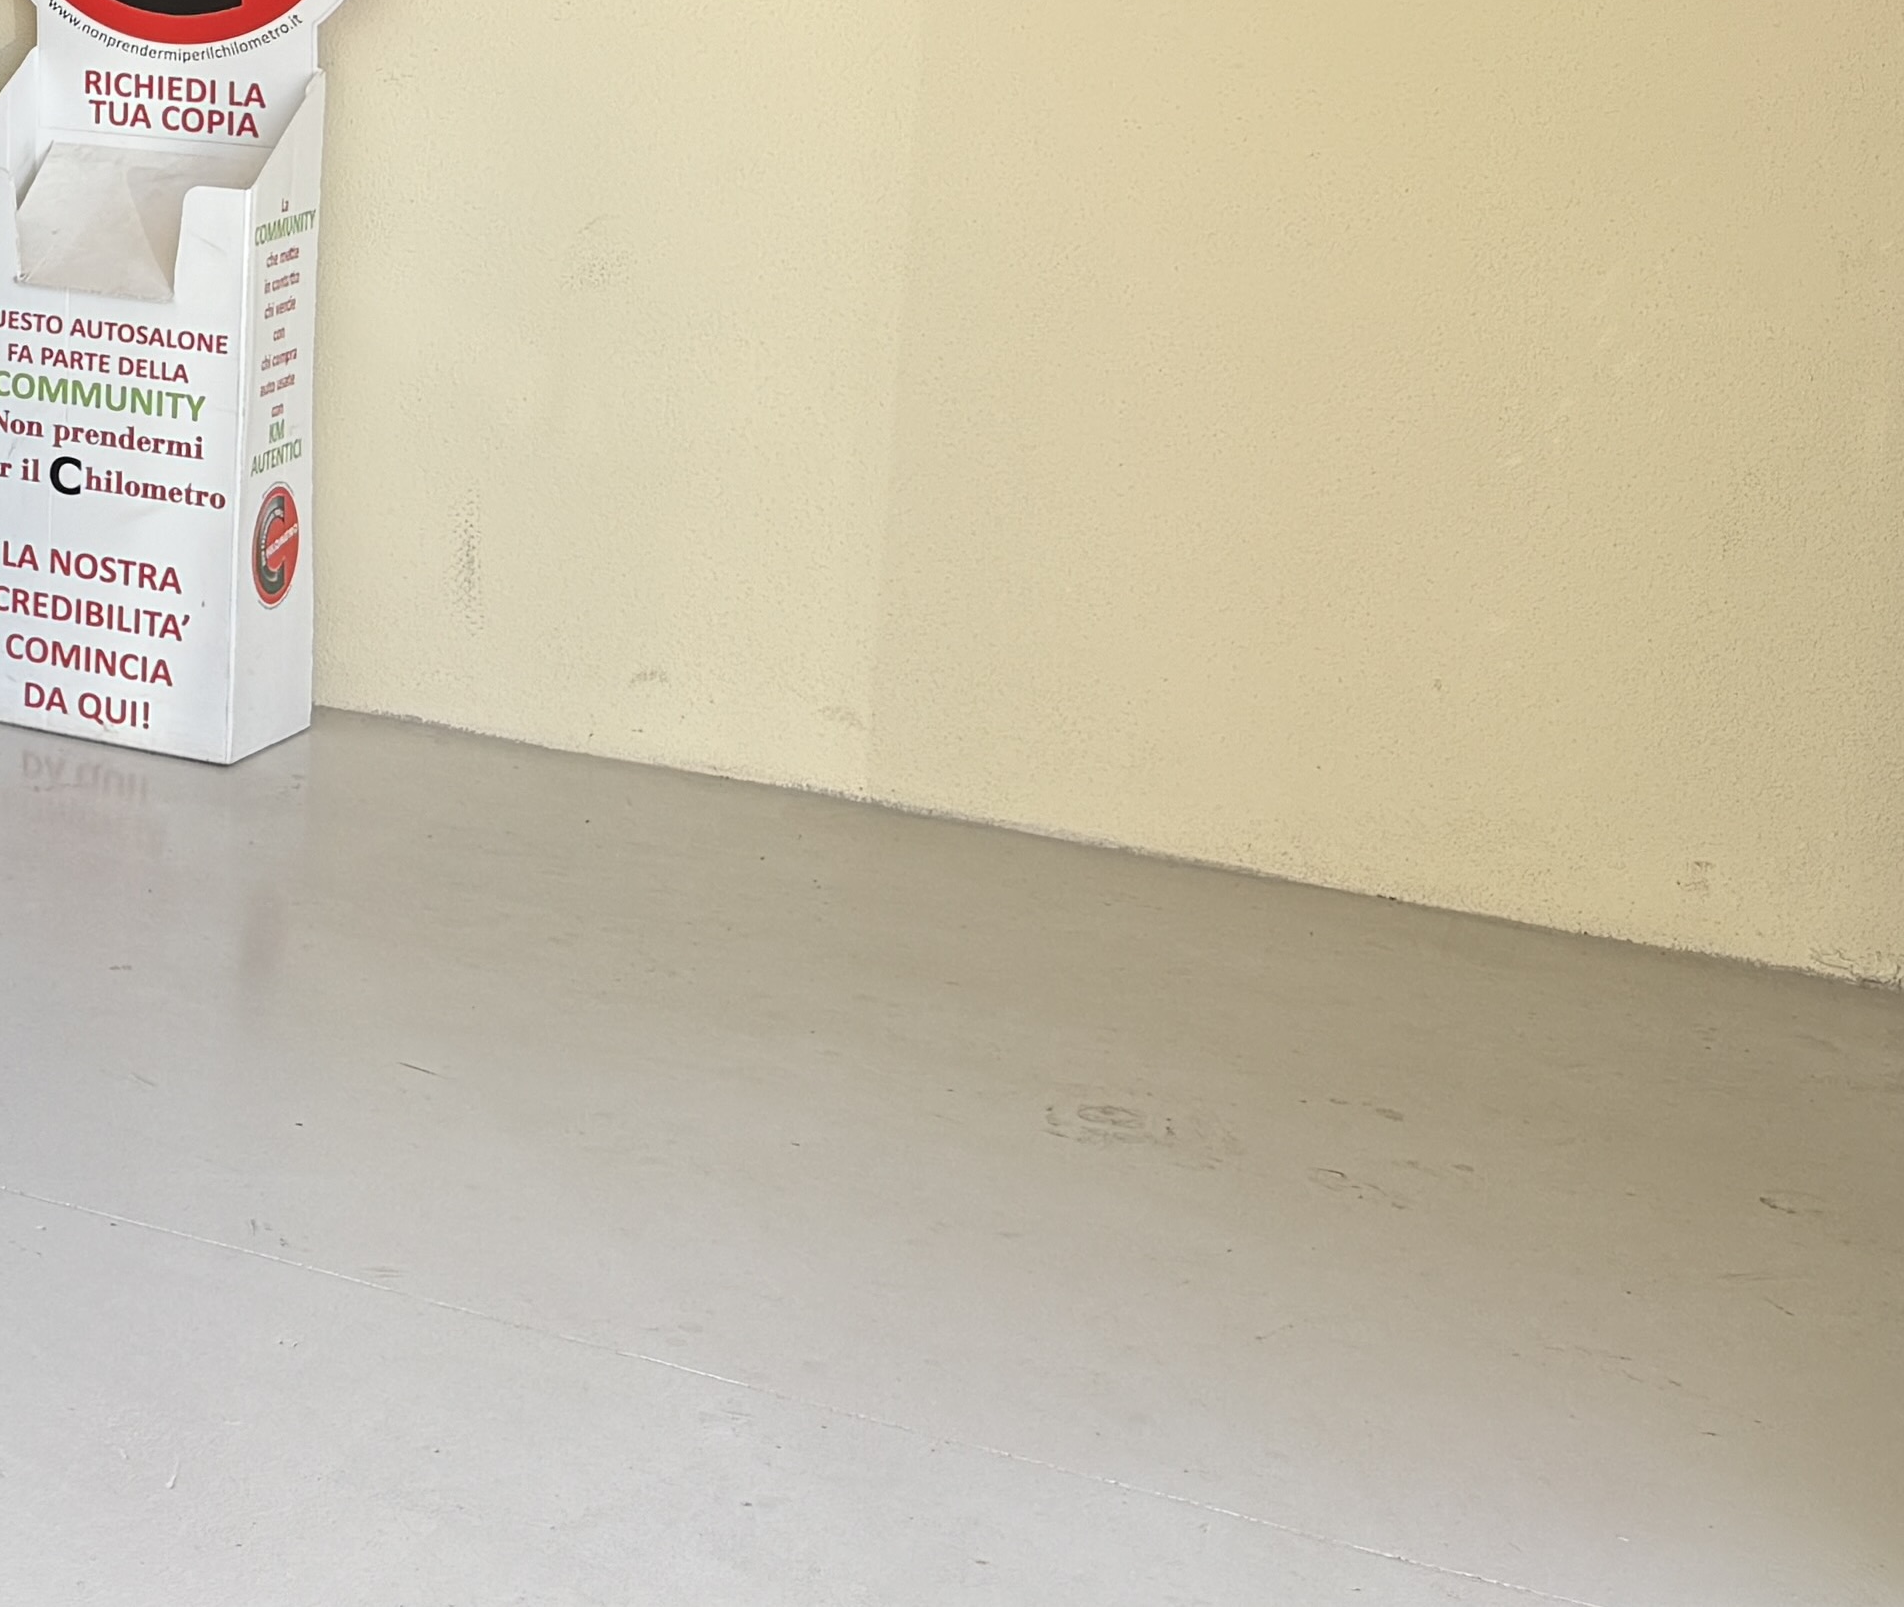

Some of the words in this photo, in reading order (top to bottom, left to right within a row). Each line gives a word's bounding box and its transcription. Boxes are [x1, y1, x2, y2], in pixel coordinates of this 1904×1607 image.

[84, 70, 217, 105] RICHIEDI
[228, 81, 267, 109] LA
[89, 99, 152, 130] TUA
[160, 106, 259, 139] COPIA
[255, 209, 316, 246] COMMUNITY
[70, 318, 229, 355] AUTOSALONE
[7, 343, 34, 364] FA
[40, 346, 111, 374] PARTE
[118, 357, 189, 384] DELLA
[53, 422, 204, 460] prendermi
[250, 439, 302, 477] AUTENTICI
[21, 457, 40, 482] il
[2, 540, 40, 571] LA
[49, 548, 182, 595] NOSTRA
[5, 632, 174, 687] COMINCIA
[23, 681, 68, 714] DA
[77, 688, 151, 730] QUI!
